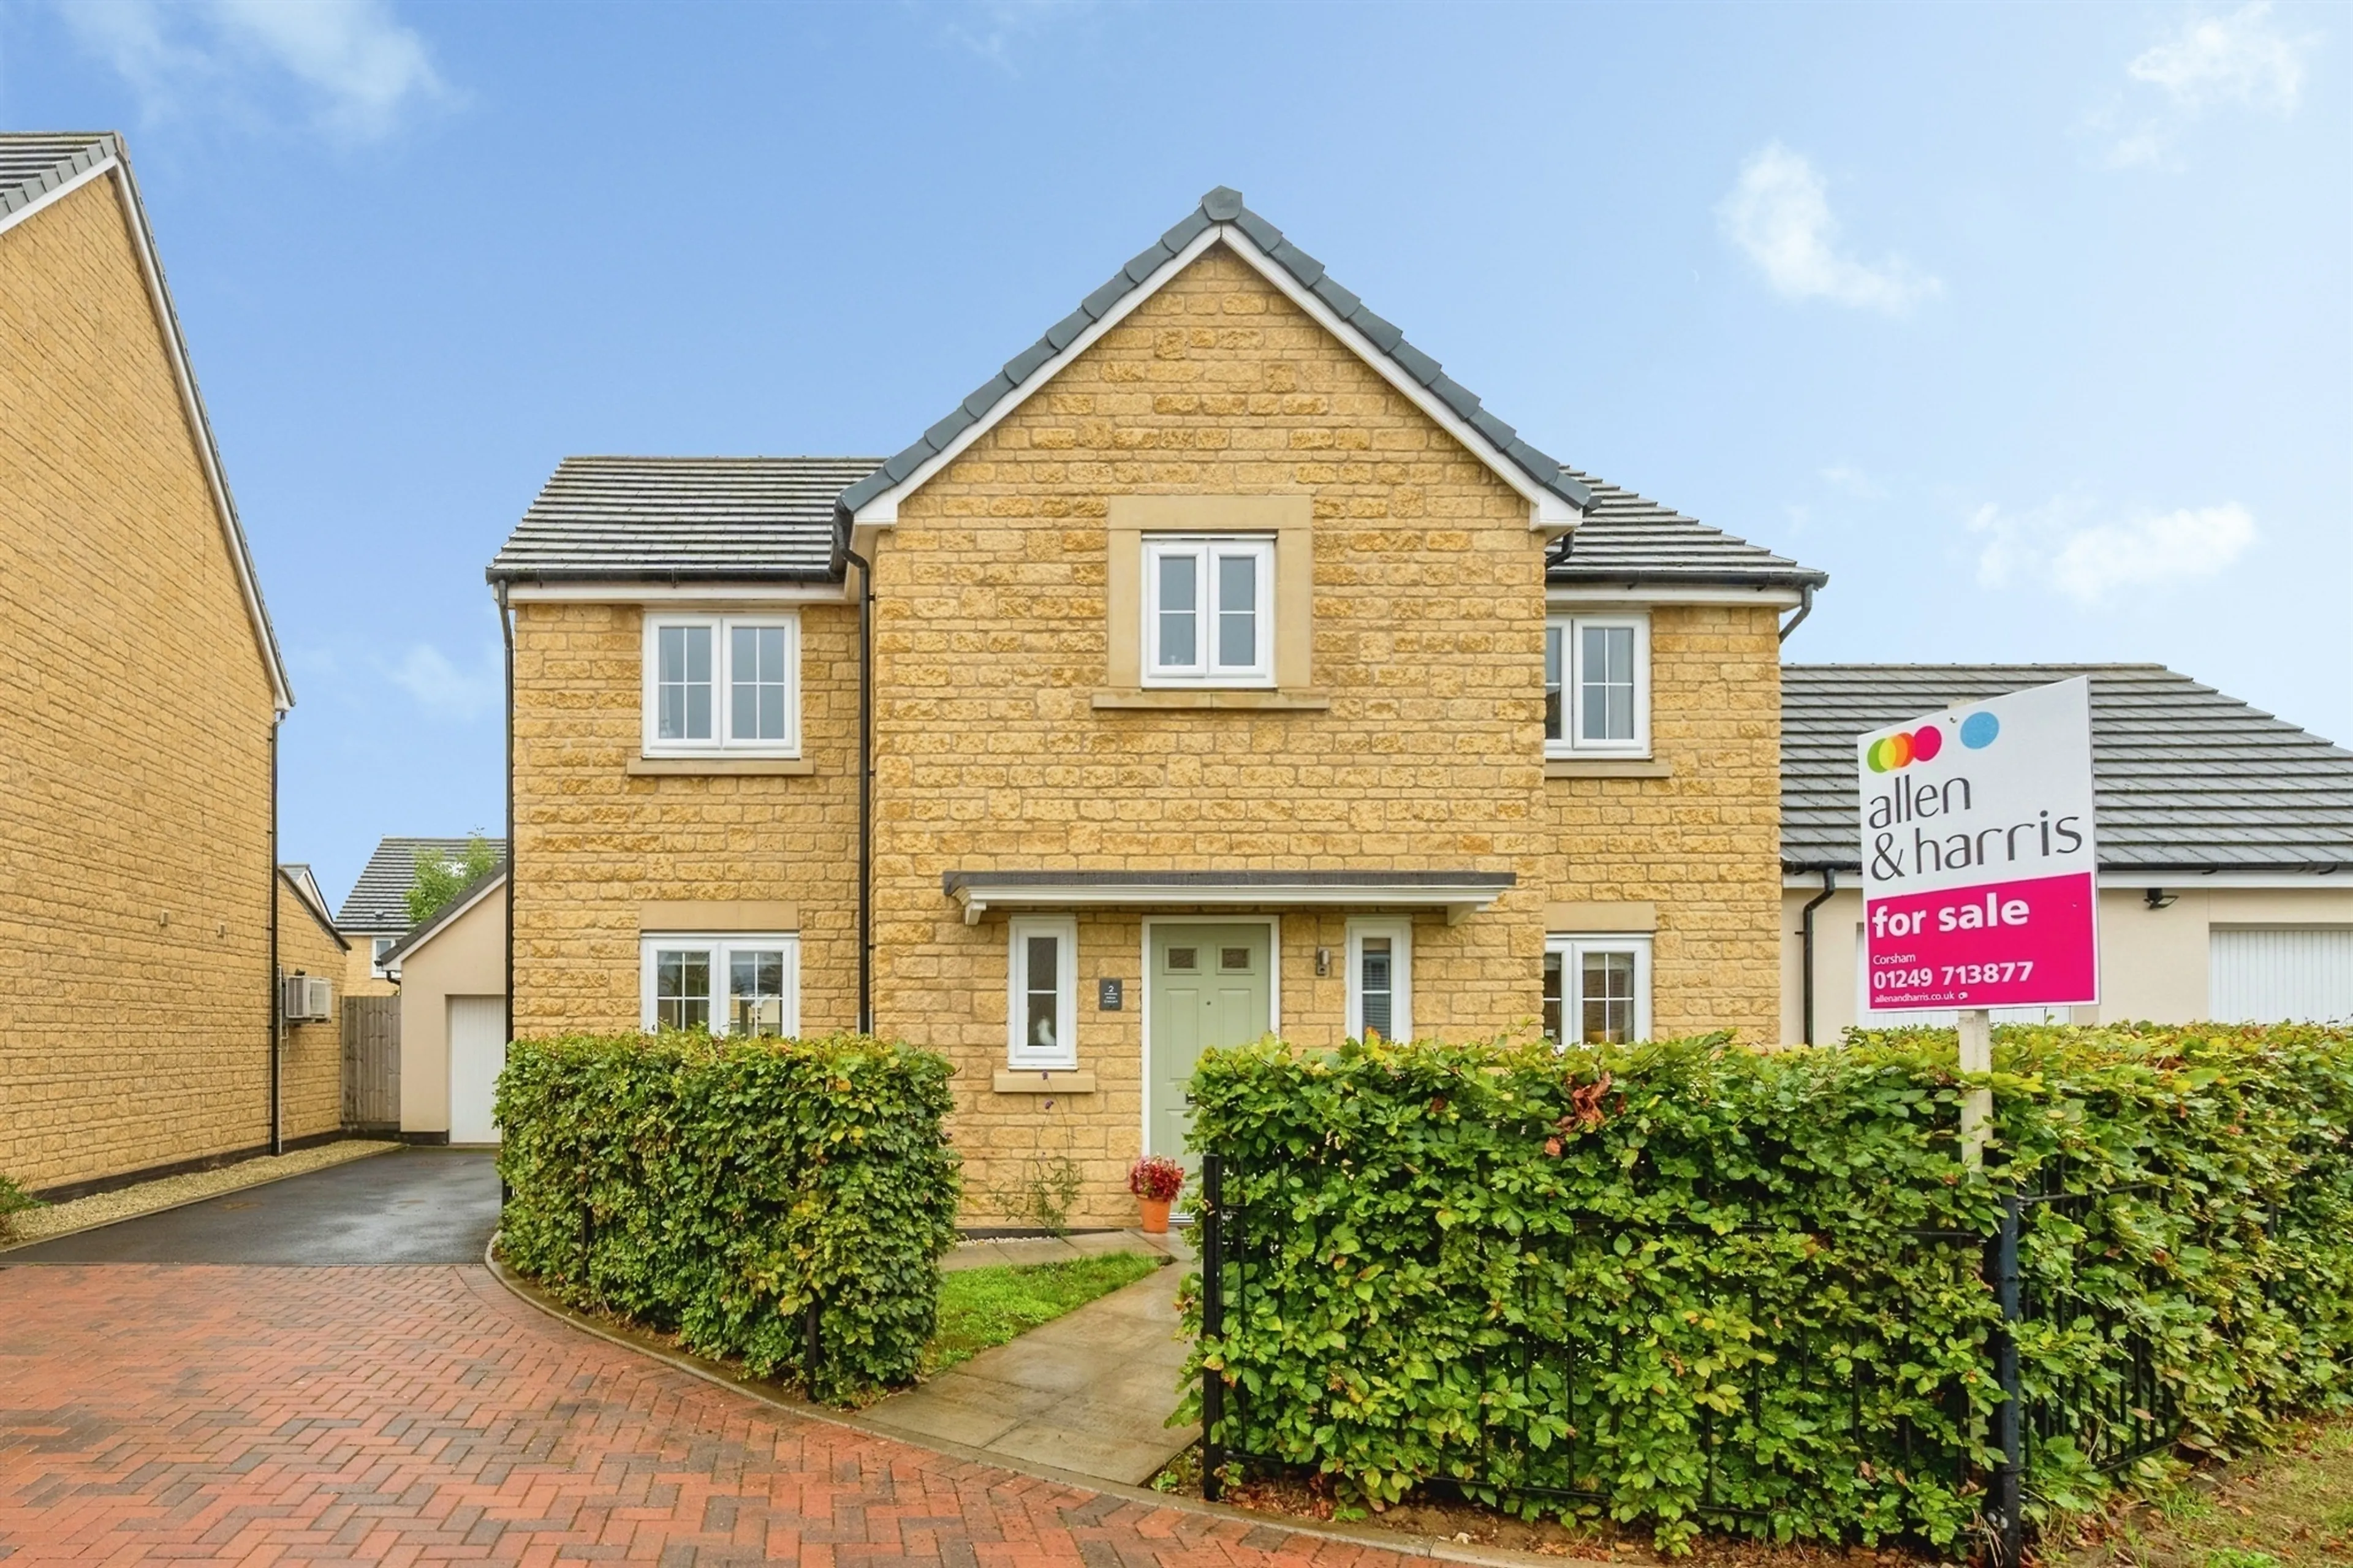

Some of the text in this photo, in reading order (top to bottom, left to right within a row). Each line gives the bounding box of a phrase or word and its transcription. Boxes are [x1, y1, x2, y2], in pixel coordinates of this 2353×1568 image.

[1868, 774, 1971, 829] allen
[1871, 809, 2083, 881] & harris
[1872, 892, 2030, 938] for sale
[1873, 952, 1916, 965] Corsham
[1873, 961, 2034, 989] 01249 713877
[1874, 991, 1955, 1003] allenandharris.co.uk
